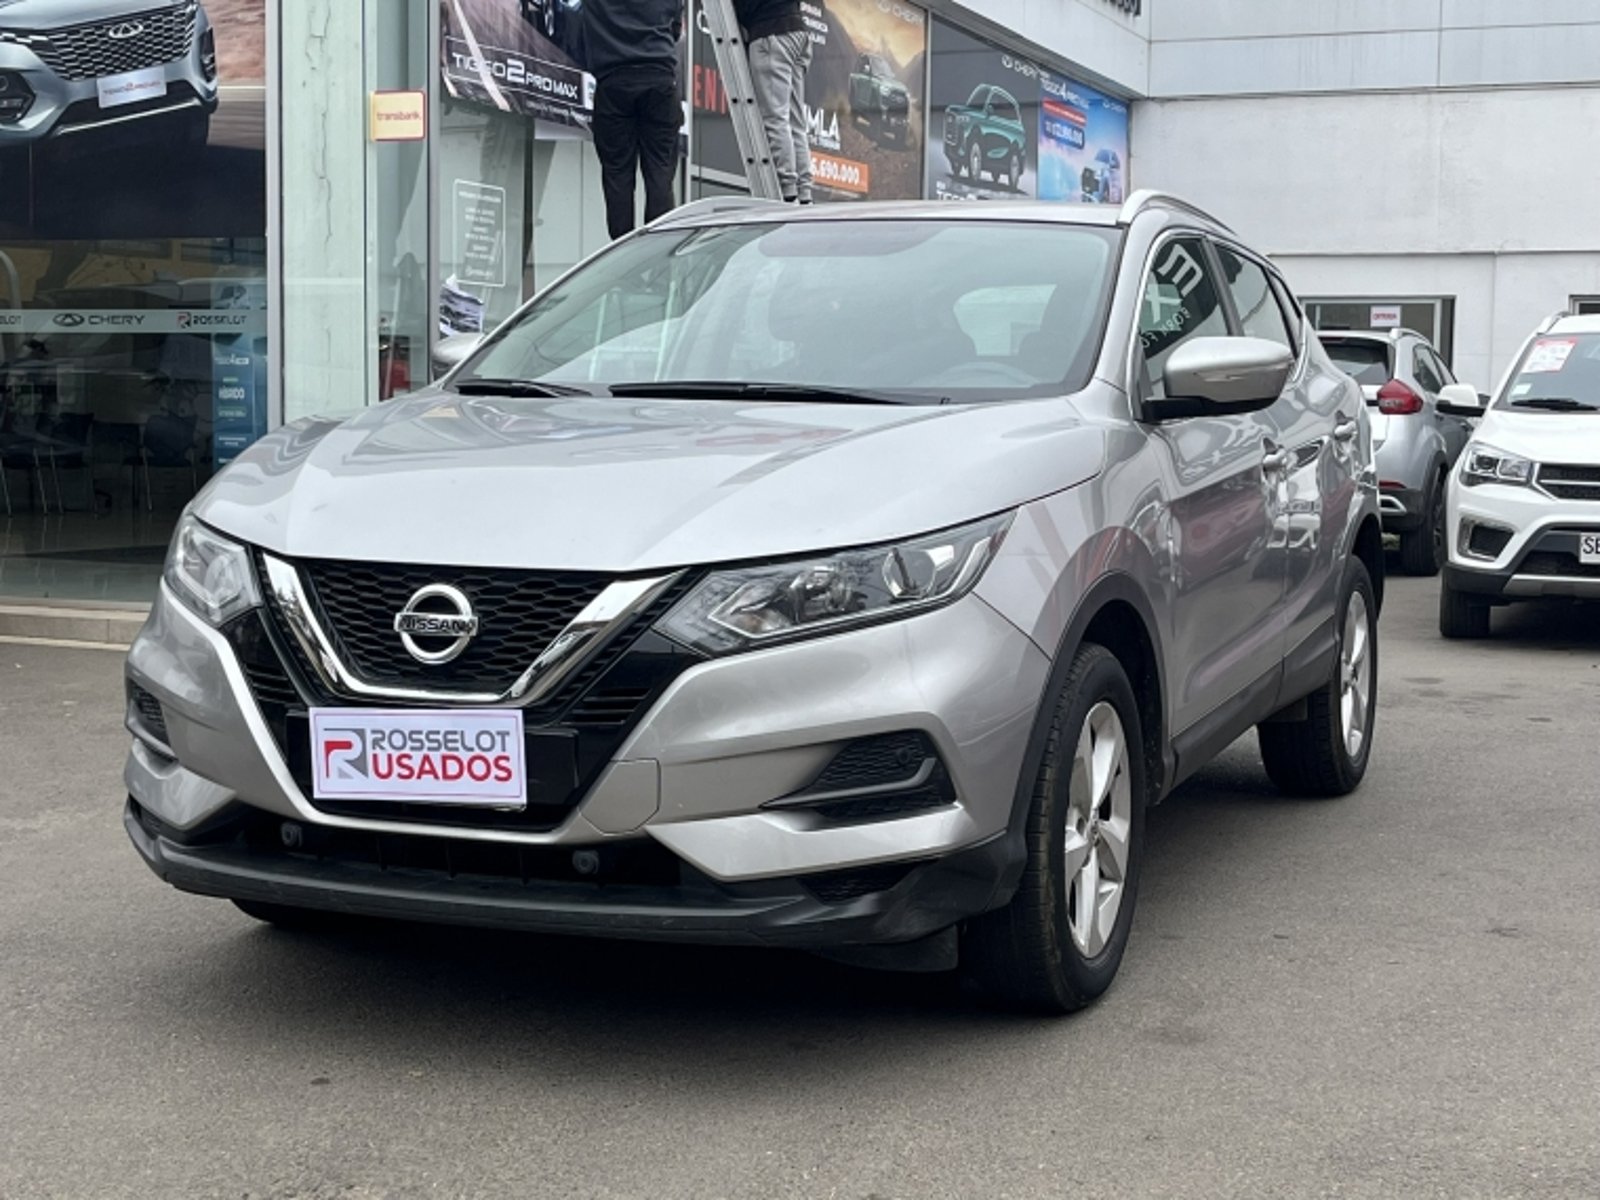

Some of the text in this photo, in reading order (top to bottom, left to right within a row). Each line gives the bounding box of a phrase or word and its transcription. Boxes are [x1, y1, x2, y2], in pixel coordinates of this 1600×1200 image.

[88, 314, 146, 325] CHERY
[400, 614, 474, 634] NISSAN
[371, 729, 510, 752] ROSSELOT
[372, 753, 512, 782] USADOS
